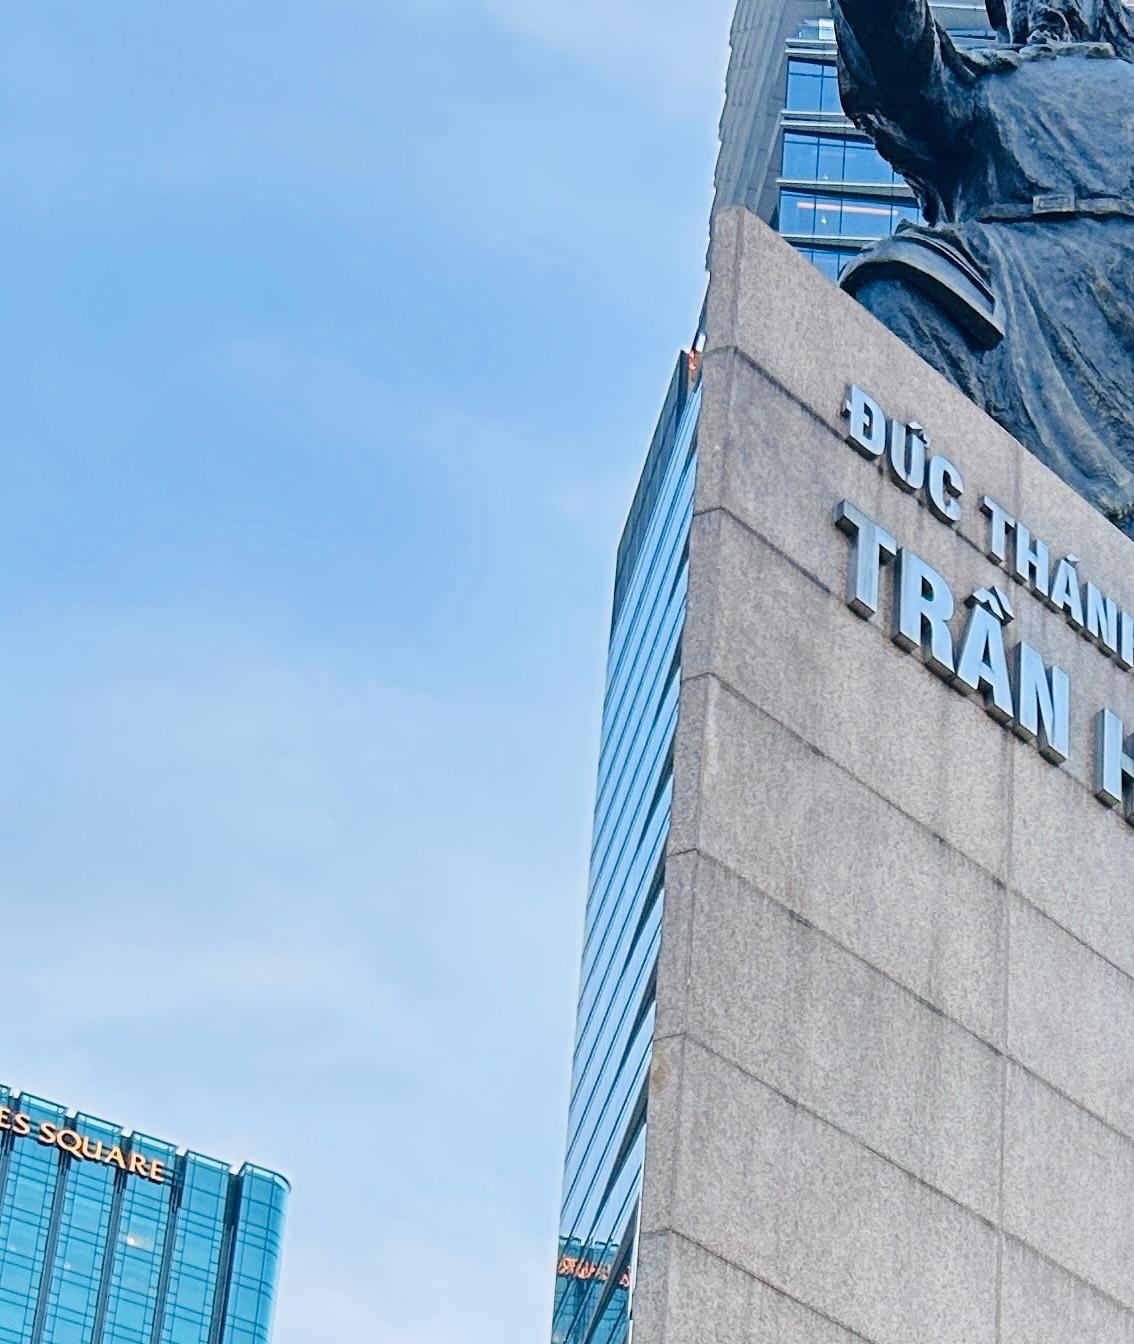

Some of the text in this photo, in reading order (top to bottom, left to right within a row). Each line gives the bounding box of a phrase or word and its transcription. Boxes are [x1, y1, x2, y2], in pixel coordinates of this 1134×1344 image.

[842, 384, 963, 523] ĐỨC
[834, 499, 1069, 765] TRẦN
[38, 1121, 165, 1182] SQUARE
